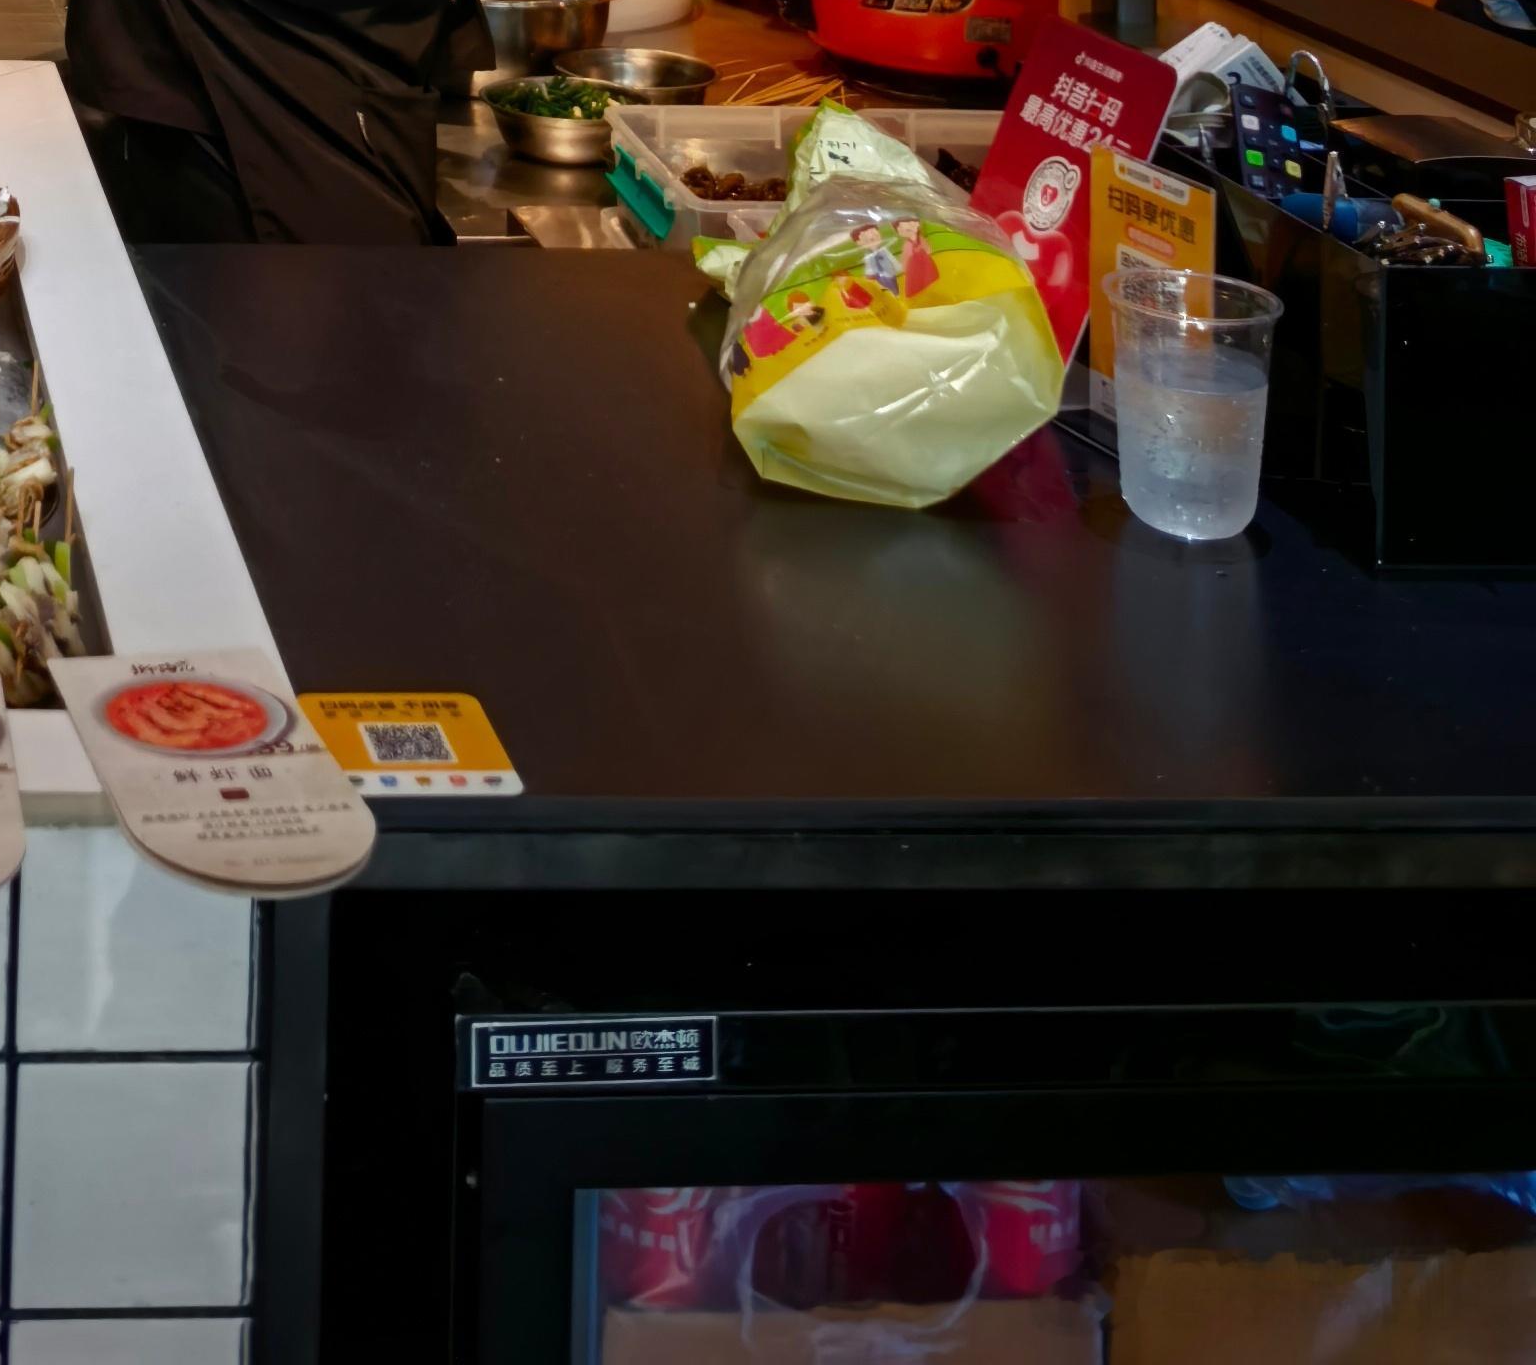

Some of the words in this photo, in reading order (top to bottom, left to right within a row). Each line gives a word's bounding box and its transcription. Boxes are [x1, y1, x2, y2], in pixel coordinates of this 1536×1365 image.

[1049, 72, 1124, 127] 抖音扫码
[1107, 186, 1197, 245] 扫码享优惠
[630, 1029, 700, 1049] 欧杰顿
[489, 1060, 585, 1078] 品质至上
[605, 1056, 701, 1074] 服务至诚
